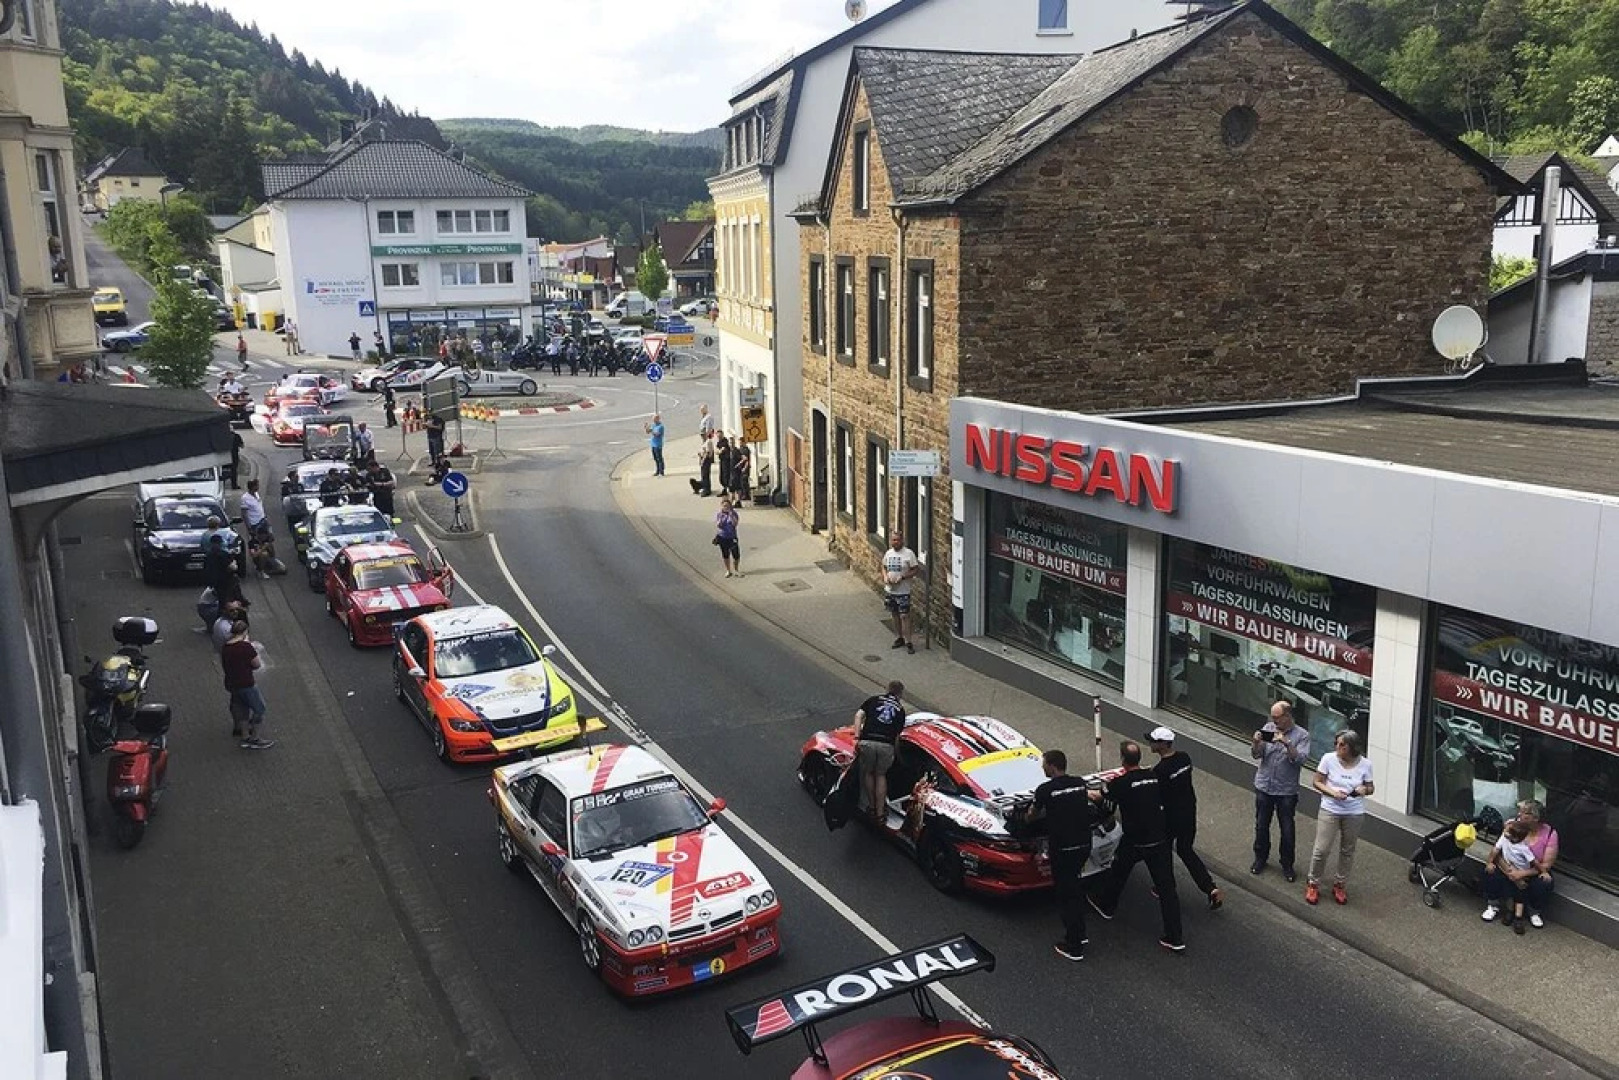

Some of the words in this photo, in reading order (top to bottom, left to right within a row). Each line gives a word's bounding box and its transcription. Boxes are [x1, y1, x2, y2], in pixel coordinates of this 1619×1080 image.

[966, 423, 1178, 513] NISSAN
[1005, 528, 1112, 569] TAGESZULASSUNGEN
[1011, 543, 1035, 563] WIR
[1037, 553, 1080, 577] BAUEN
[1084, 567, 1107, 586] UM
[1191, 580, 1349, 641] TAGESZULASSUNGEN
[1197, 603, 1229, 626] WIR
[1235, 614, 1298, 648] BAUEN
[1304, 635, 1336, 660] UM
[1465, 661, 1619, 722] TAGESZULASS
[1479, 688, 1529, 720] WIR
[1539, 705, 1619, 748] BAUE
[610, 868, 647, 885] 120
[793, 945, 979, 1017] RONAL
